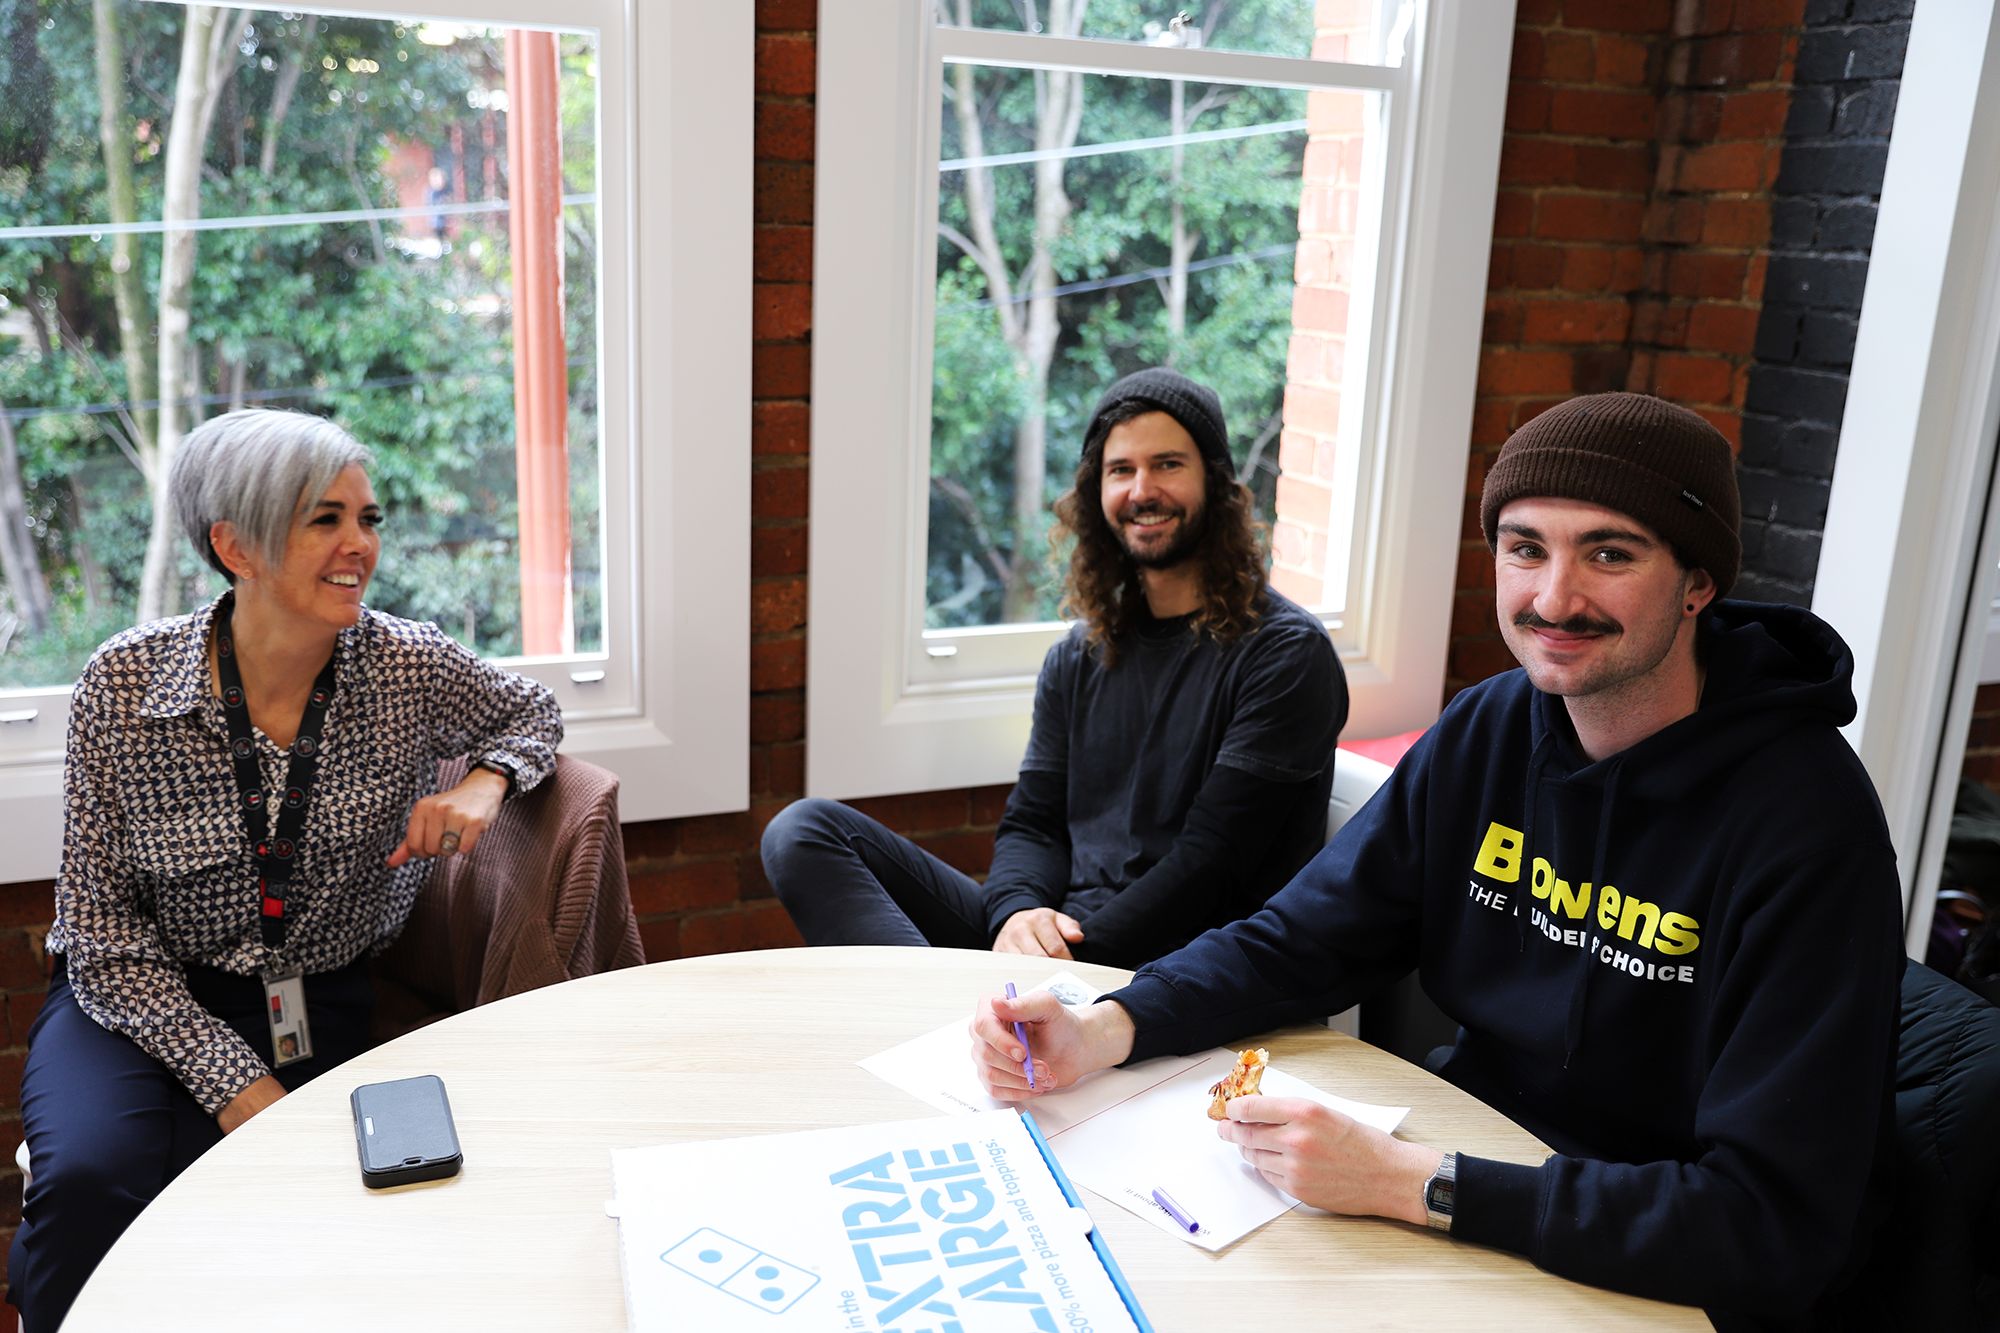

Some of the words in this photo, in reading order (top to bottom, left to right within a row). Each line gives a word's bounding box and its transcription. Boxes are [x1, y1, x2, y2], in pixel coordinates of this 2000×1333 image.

[1469, 880, 1508, 911] THE
[1600, 944, 1694, 983] CHOICE
[1007, 1198, 1035, 1222] and
[829, 1151, 965, 1333] XTRA
[902, 1142, 1060, 1333] ARGE
[1027, 1224, 1060, 1260] pizza
[1046, 1263, 1075, 1300] more
[837, 1289, 860, 1314] the
